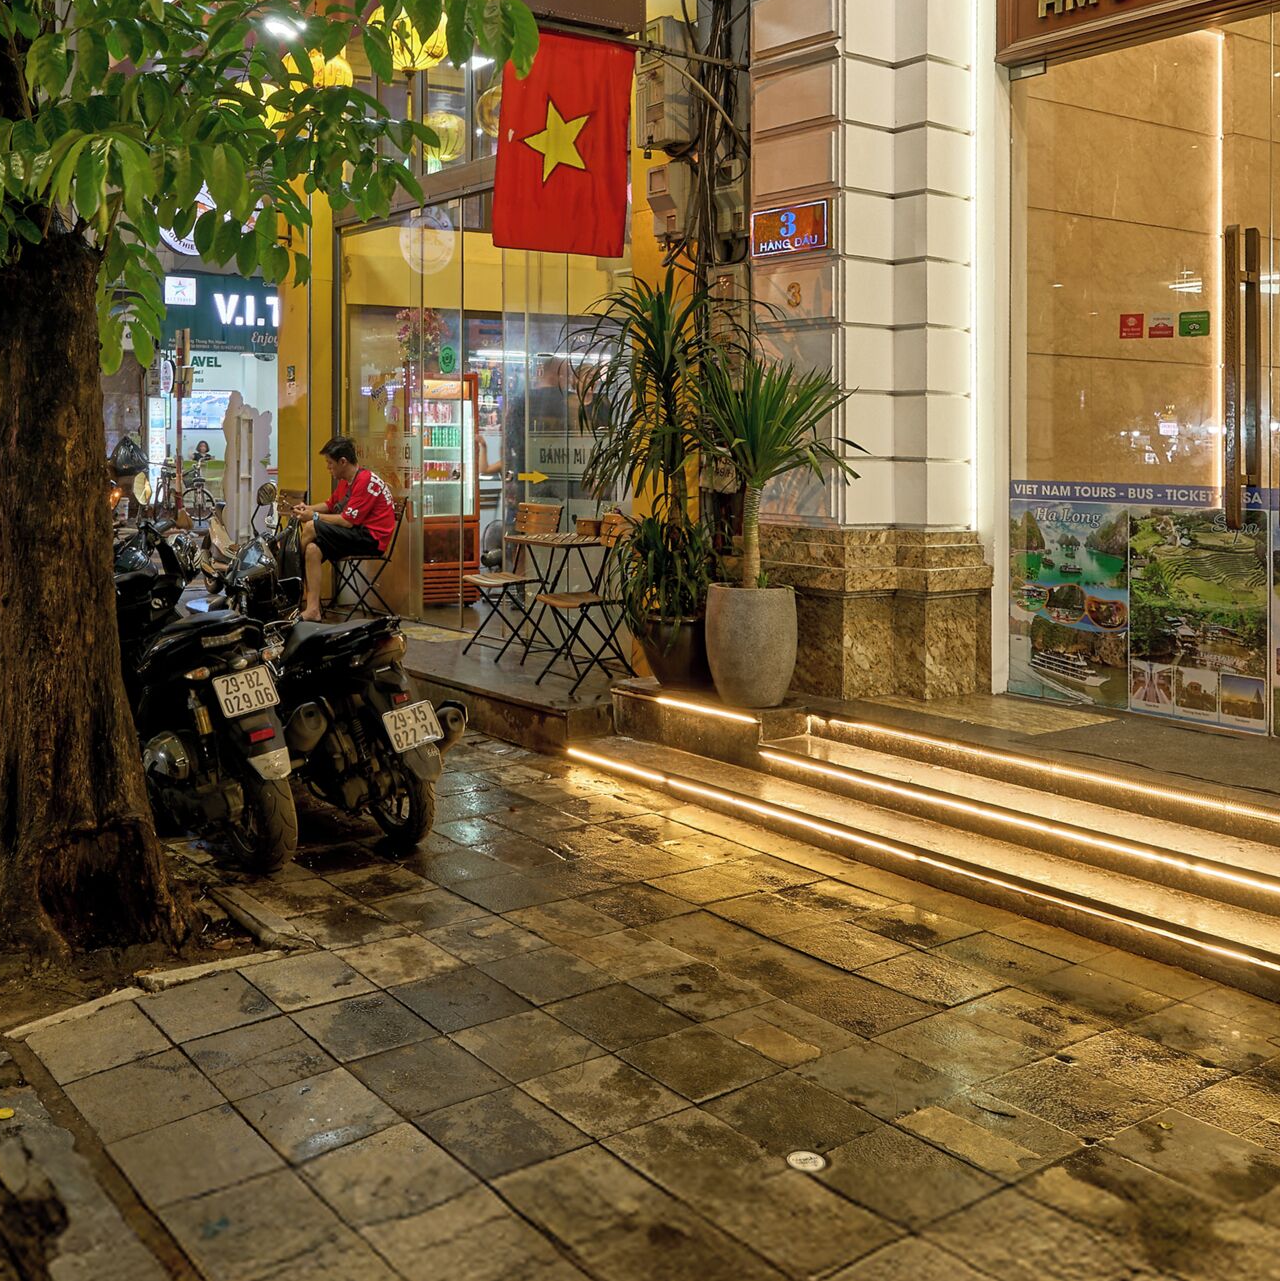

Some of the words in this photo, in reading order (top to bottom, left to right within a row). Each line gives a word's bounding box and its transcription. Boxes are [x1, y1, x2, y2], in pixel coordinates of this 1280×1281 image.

[779, 211, 797, 237] 3
[787, 281, 801, 308] 3
[540, 444, 568, 465] BÁNH
[1013, 483, 1038, 496] VIET
[1041, 485, 1071, 497] NAM
[1073, 486, 1116, 498] TOURS
[1128, 488, 1154, 500] BUS
[346, 507, 358, 519] 24
[1036, 506, 1059, 522] Ha
[1061, 509, 1102, 529] Long
[221, 671, 264, 696] 29-B2
[224, 688, 276, 715] 029.06
[390, 705, 428, 731] 29-X5
